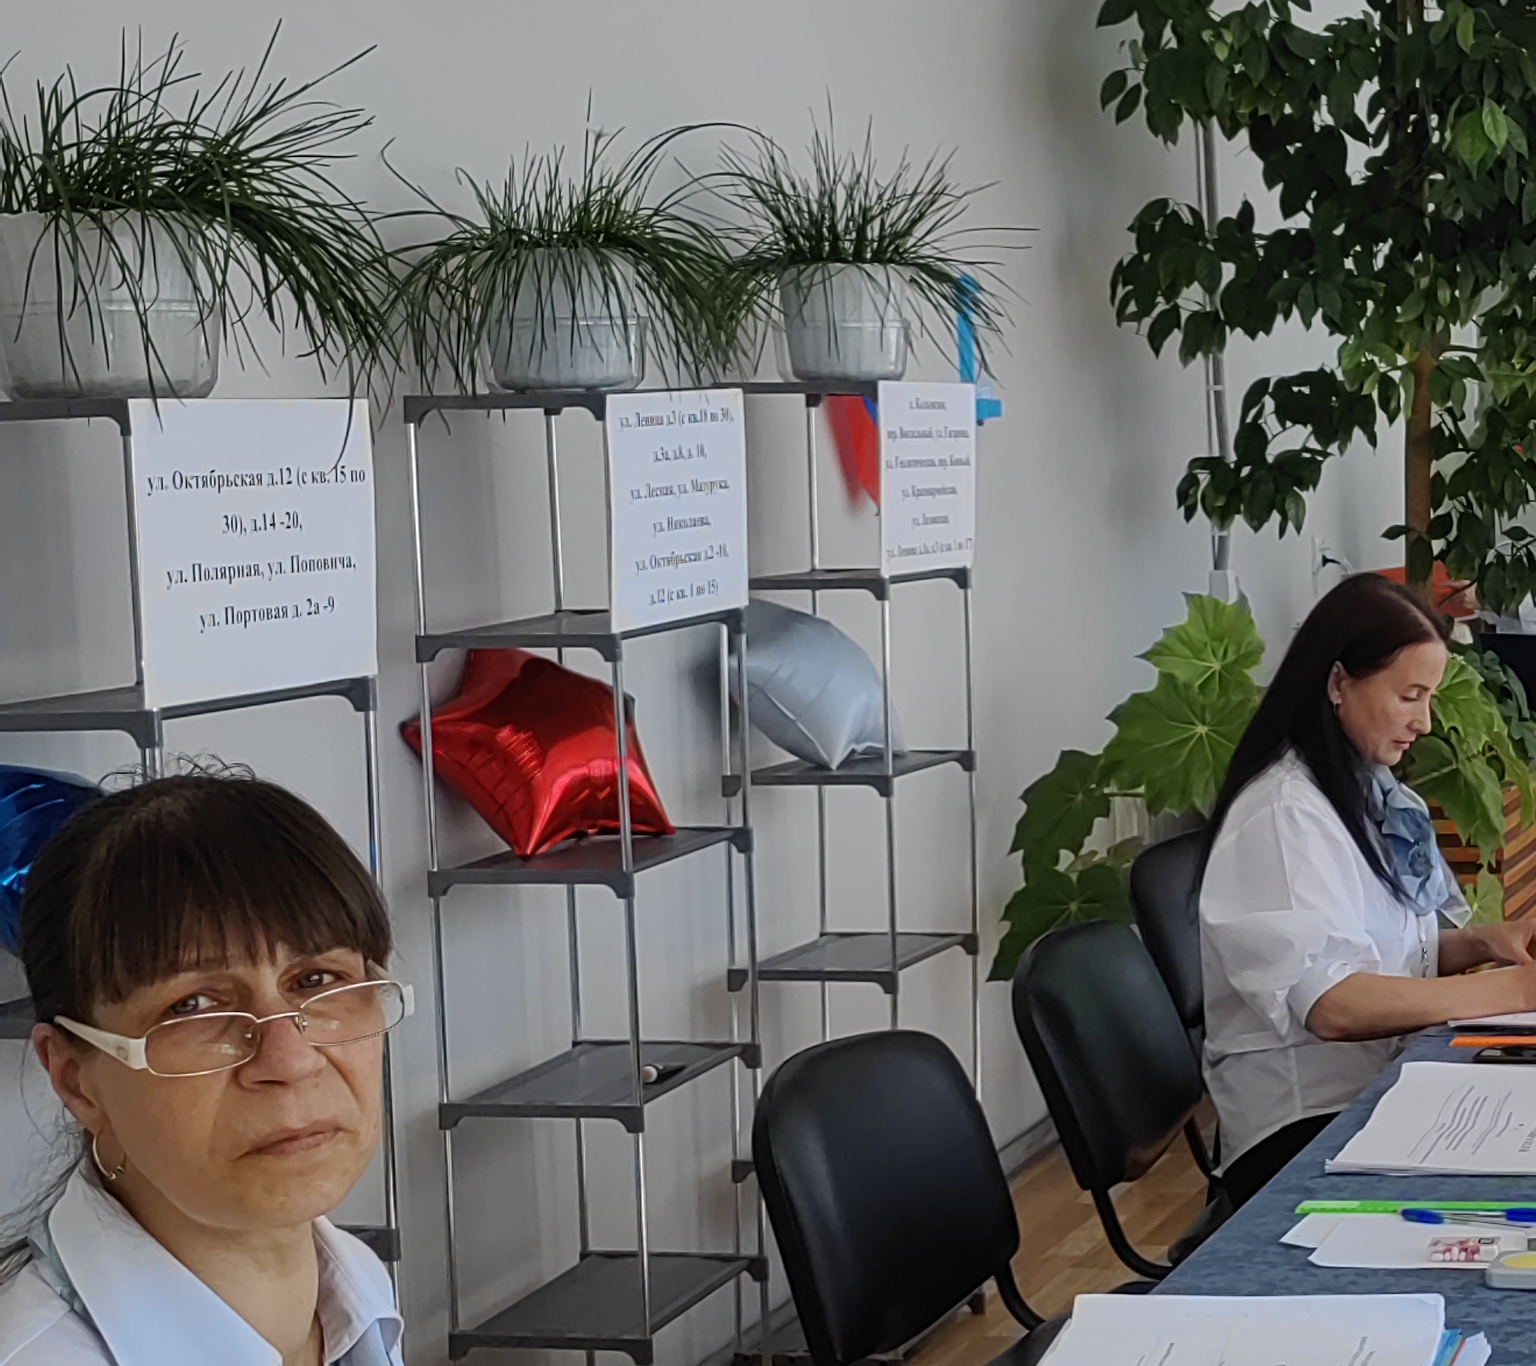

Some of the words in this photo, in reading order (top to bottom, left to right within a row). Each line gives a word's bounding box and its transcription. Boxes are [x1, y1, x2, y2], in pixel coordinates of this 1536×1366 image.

[146, 476, 169, 497] ул.
[172, 469, 263, 494] Октябрьская
[267, 467, 293, 488] д.12
[296, 466, 308, 490] (с
[311, 470, 330, 485] кв.
[333, 465, 347, 484] 15
[350, 469, 366, 483] по
[222, 513, 247, 538] 30),
[250, 511, 277, 534] д.14
[279, 510, 303, 532] -20,
[166, 569, 189, 591] ул.
[191, 561, 265, 585] Полярная,
[267, 561, 286, 581] ул.
[290, 554, 357, 574] Поповича,
[650, 550, 702, 570] Октябрьская
[199, 612, 221, 634] ул.
[223, 605, 289, 629] Портовая
[291, 603, 303, 620] д.
[305, 597, 321, 617] 2а
[322, 595, 336, 615] -9
